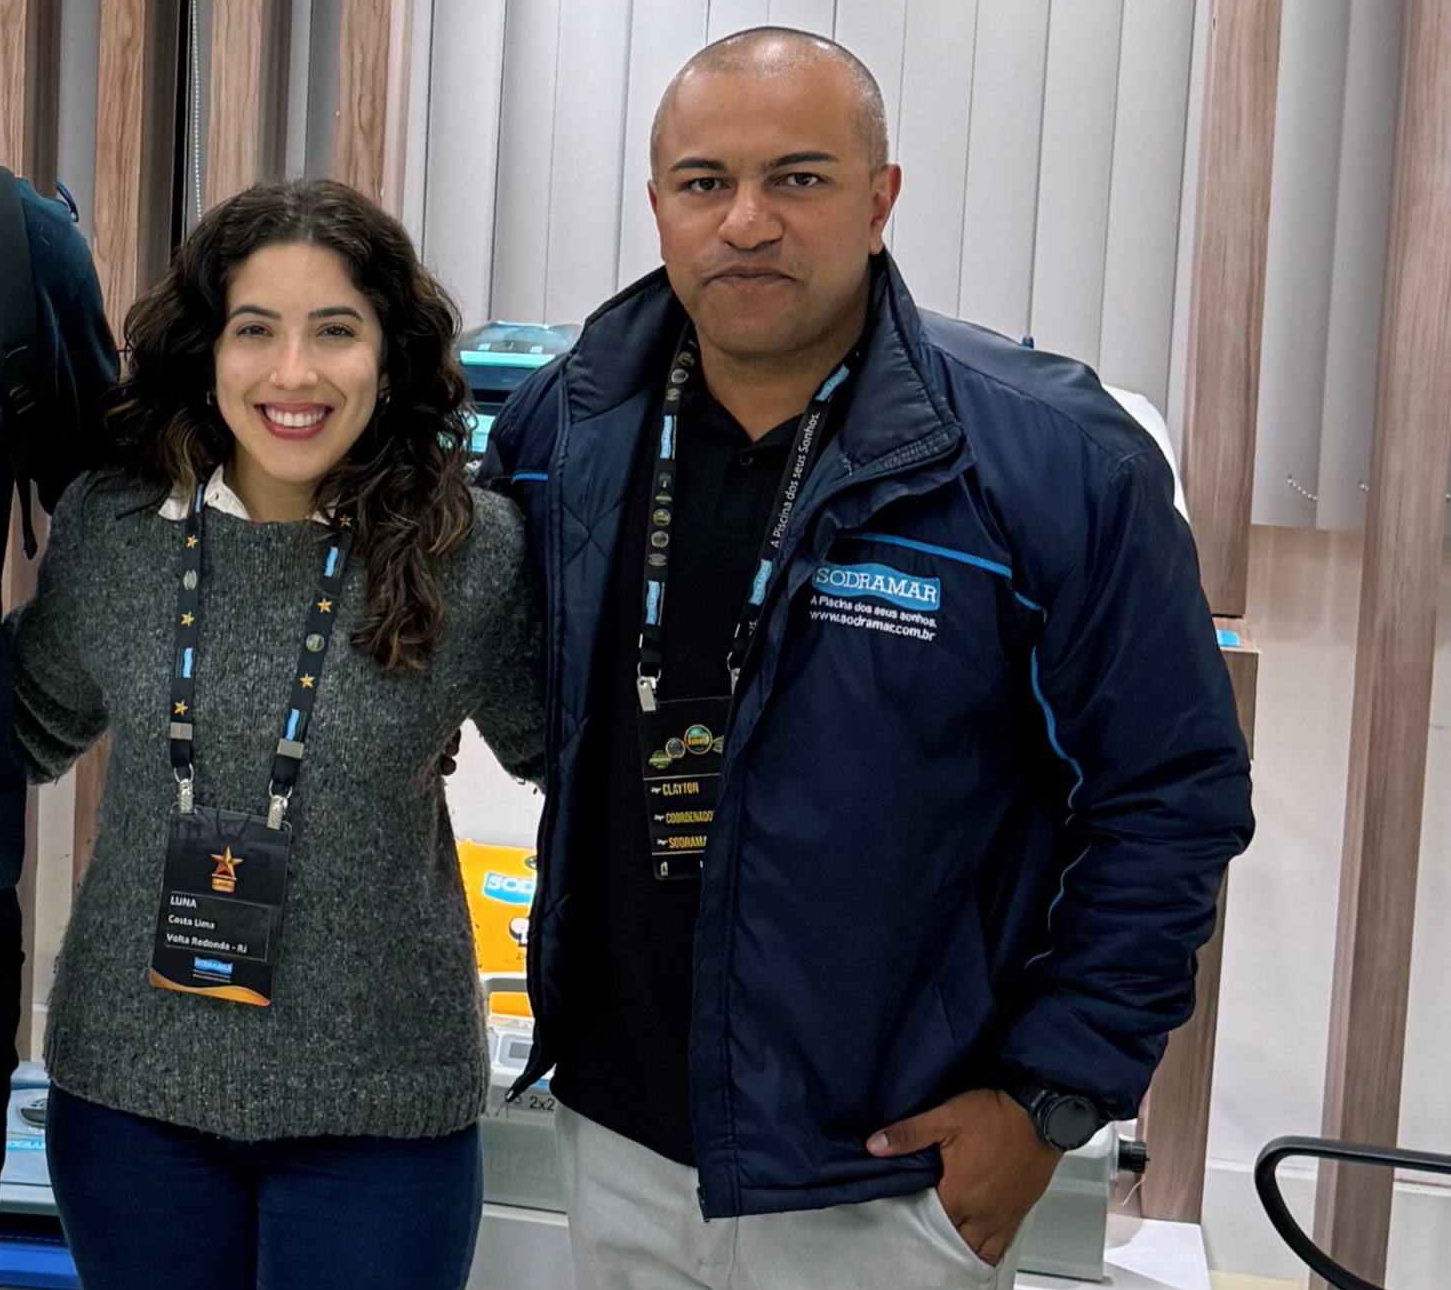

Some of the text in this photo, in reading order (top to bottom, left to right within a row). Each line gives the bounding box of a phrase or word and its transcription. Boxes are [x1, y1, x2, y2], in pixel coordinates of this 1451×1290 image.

[772, 502, 793, 538] Piscina
[784, 480, 799, 501] dos
[792, 454, 806, 480] seus
[815, 567, 938, 604] SODRAMAR
[810, 594, 818, 606] A
[818, 595, 853, 610] Piscina
[854, 601, 873, 614] dos
[873, 606, 898, 619] seus
[809, 610, 936, 642] www.sodramar.com.br
[662, 781, 700, 796] CLAYTON
[665, 810, 714, 824] COORDENADO
[170, 895, 197, 909] LUNA
[167, 914, 216, 930] Costa Lima
[166, 932, 190, 945] Volta
[191, 937, 231, 951] Redonda
[237, 943, 248, 954] RJ
[529, 1095, 556, 1112] 2x2
